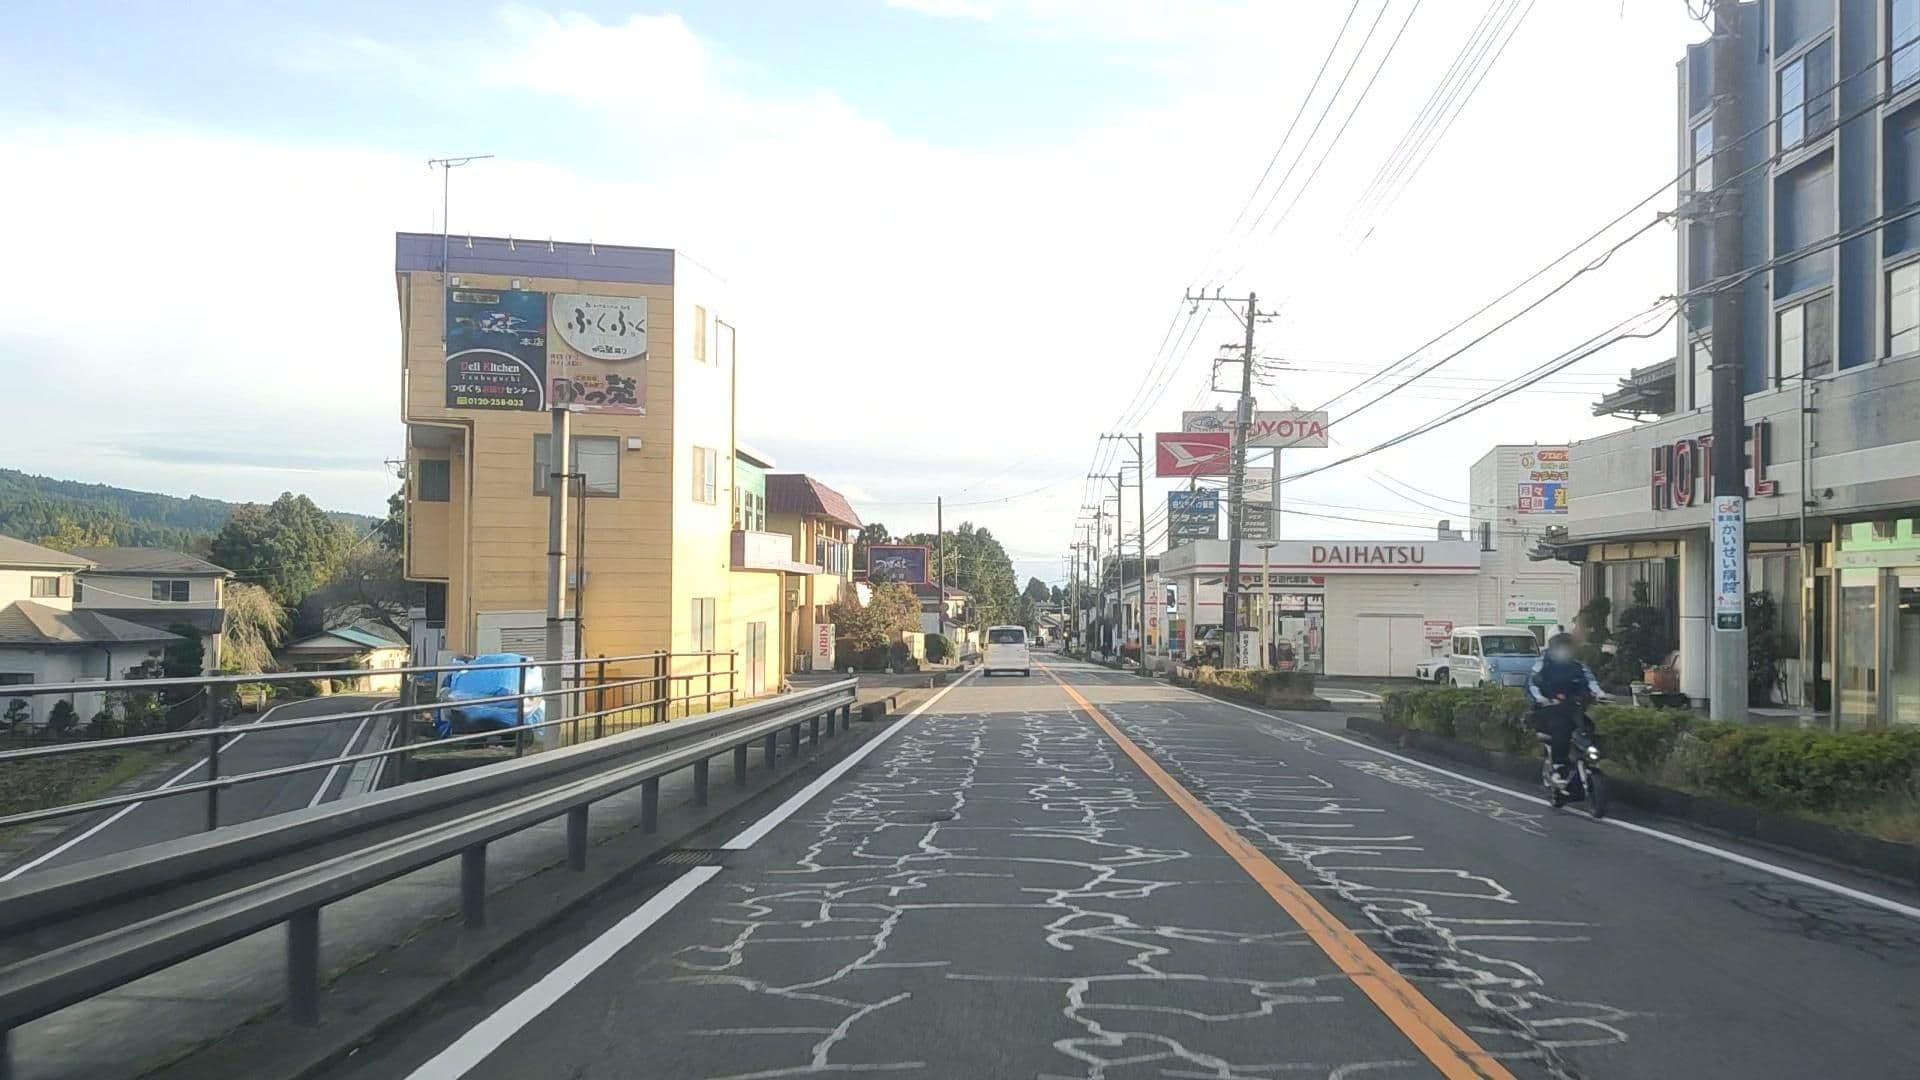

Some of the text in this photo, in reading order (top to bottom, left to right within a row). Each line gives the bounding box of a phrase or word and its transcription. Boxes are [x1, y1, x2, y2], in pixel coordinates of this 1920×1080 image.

[1651, 422, 1778, 511] HOTL
[1312, 546, 1425, 564] DAIHATSU
[819, 625, 829, 657] KIRIN
